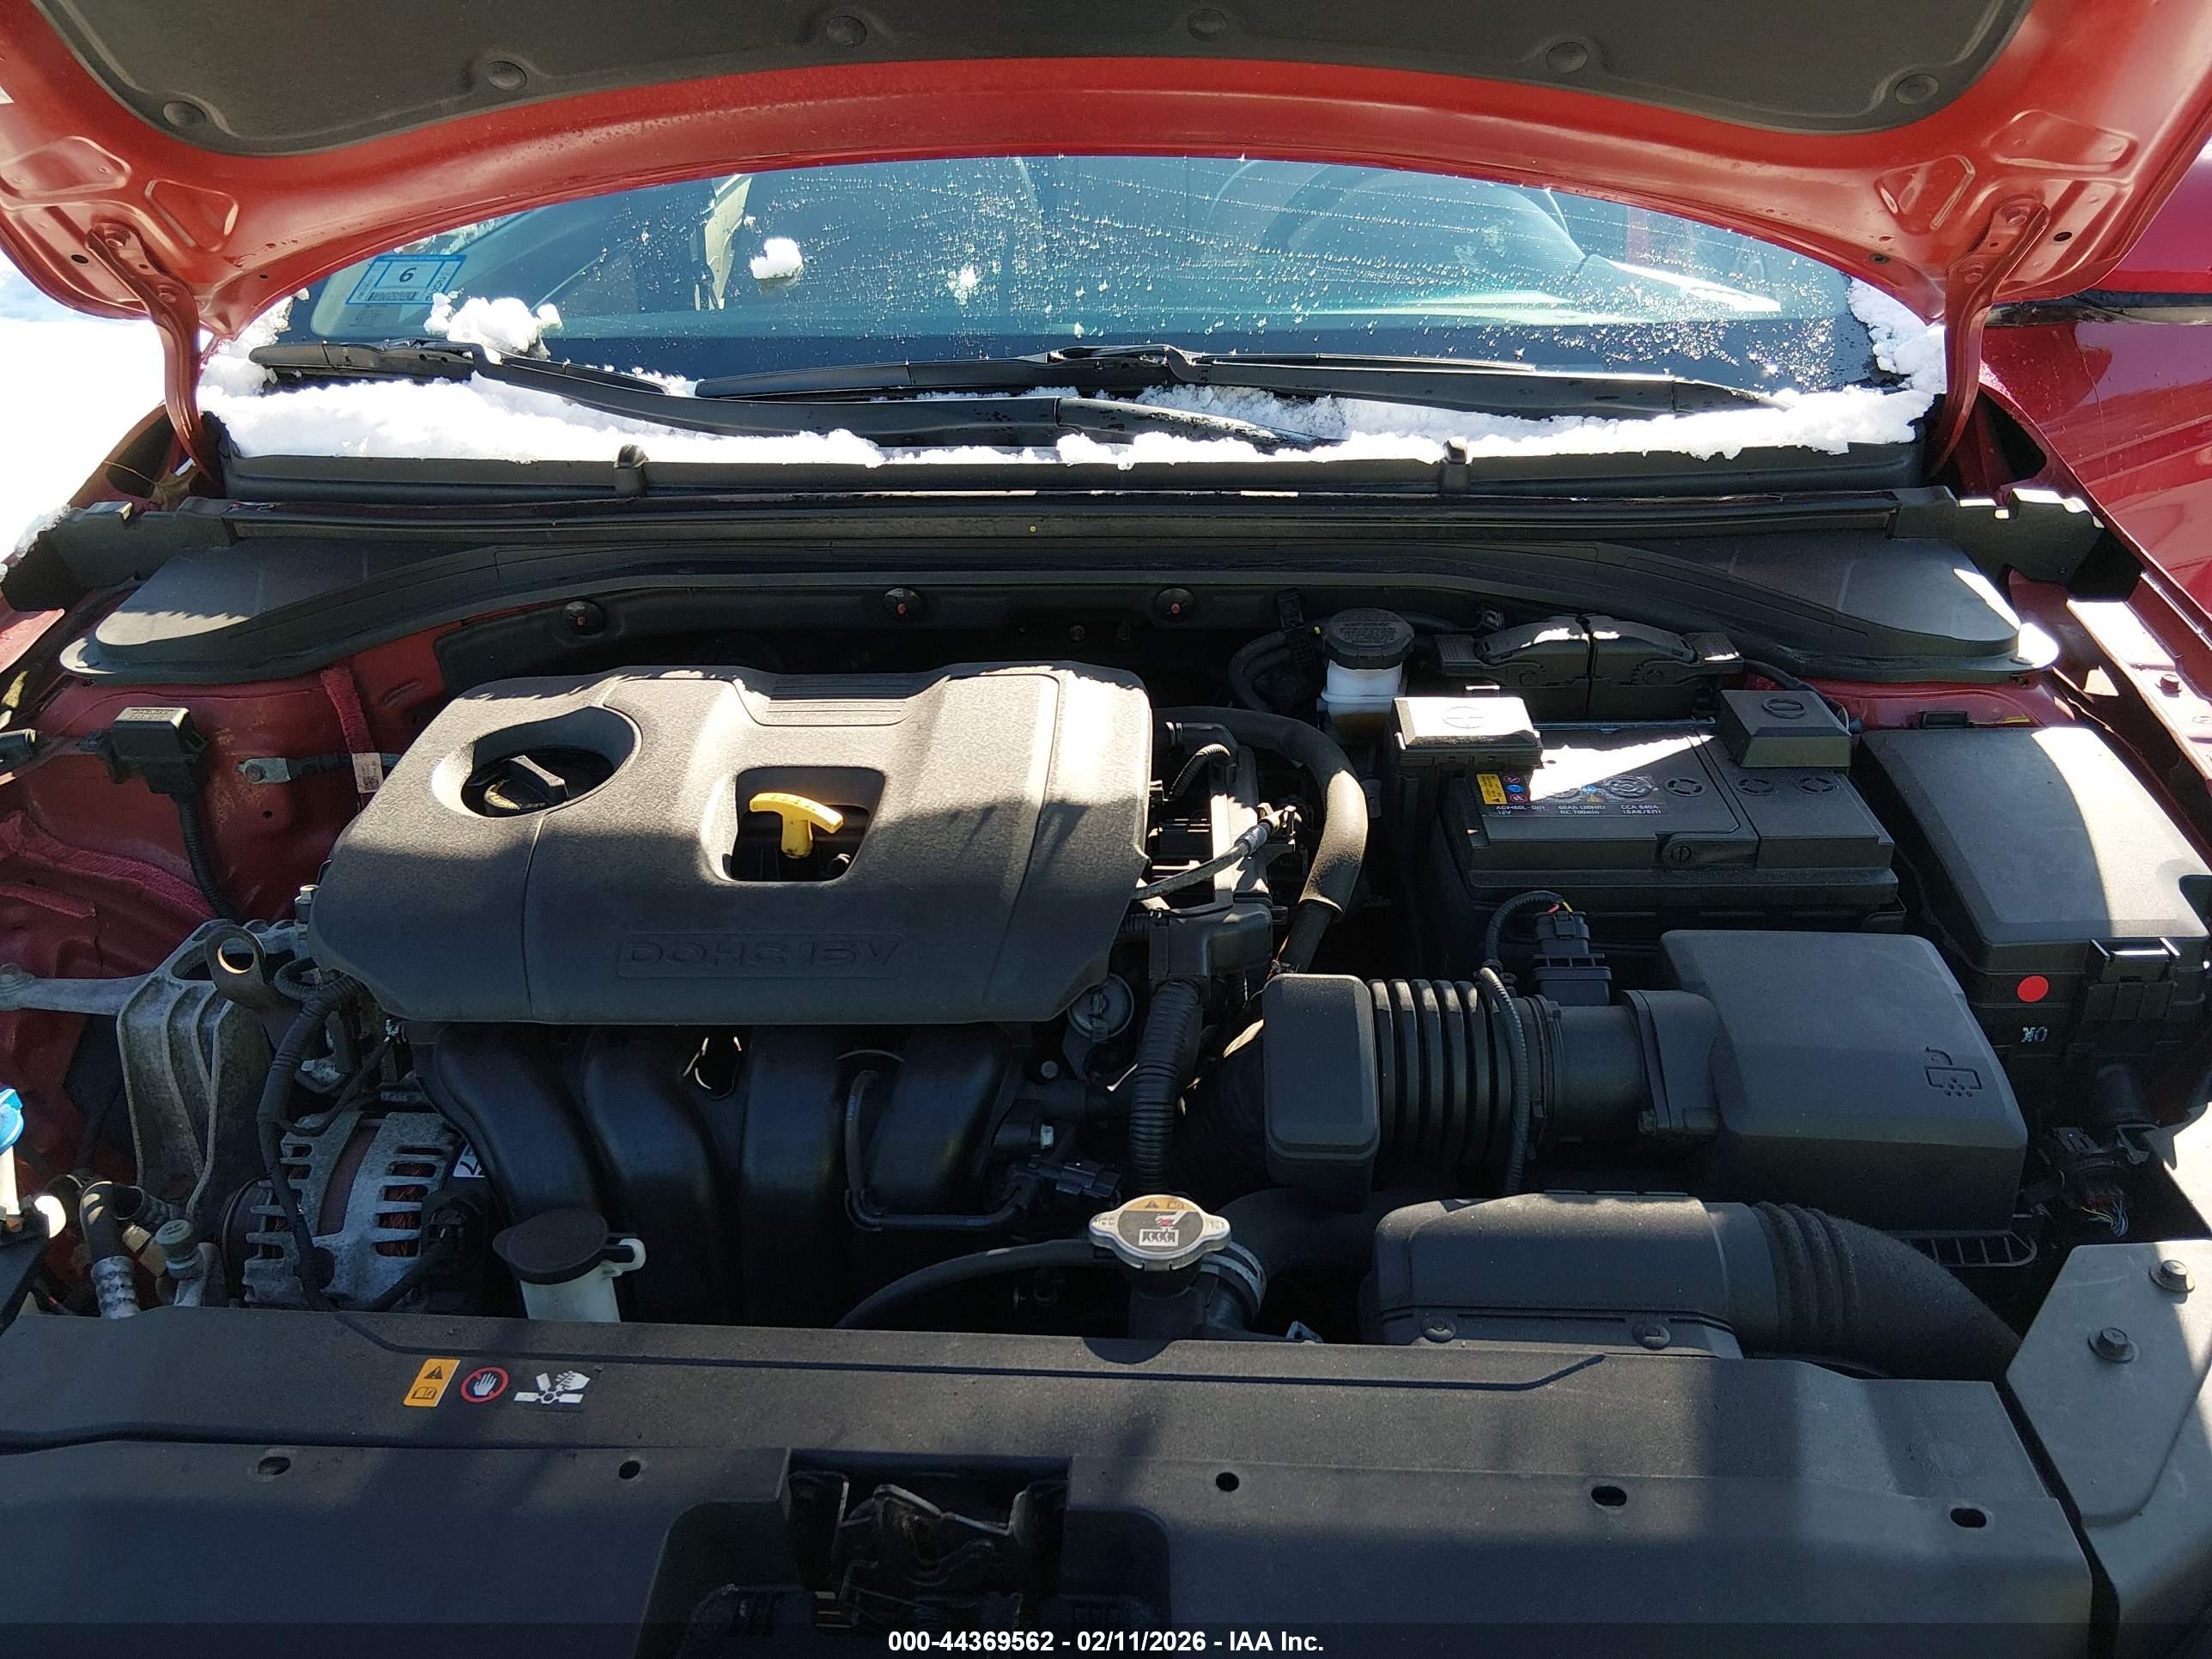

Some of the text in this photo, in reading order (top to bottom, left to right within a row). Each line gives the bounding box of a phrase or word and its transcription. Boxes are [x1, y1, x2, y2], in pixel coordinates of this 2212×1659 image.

[398, 267, 417, 283] 6
[629, 941, 901, 965] DOHC 16V
